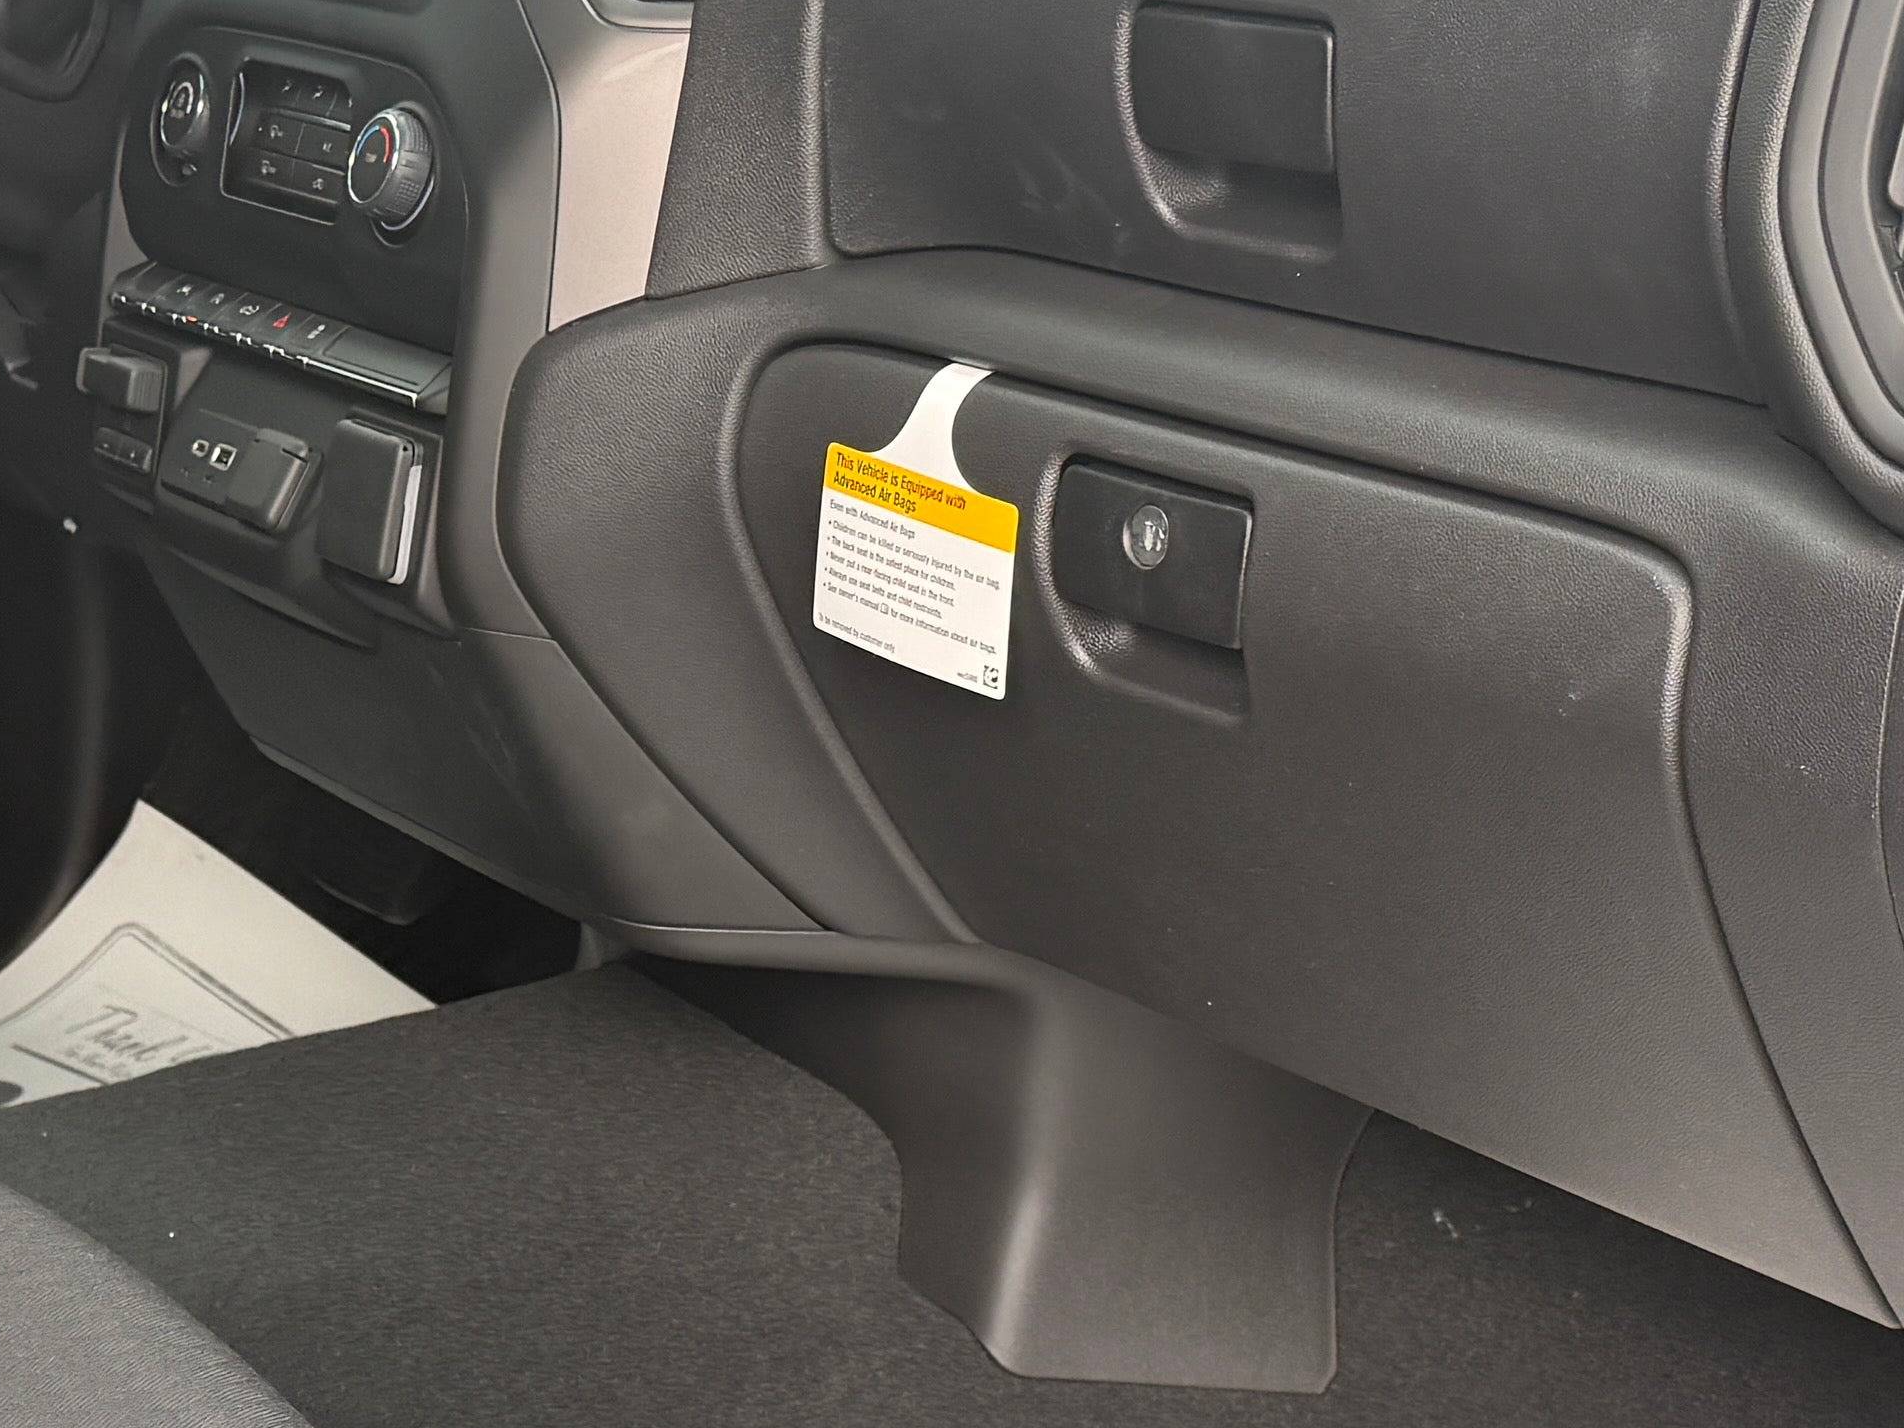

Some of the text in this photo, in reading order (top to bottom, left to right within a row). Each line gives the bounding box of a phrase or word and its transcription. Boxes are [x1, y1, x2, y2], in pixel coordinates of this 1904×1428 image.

[833, 471, 917, 514] Advanced Air Bags
[836, 452, 968, 510] This Vehicle is Equipped with
